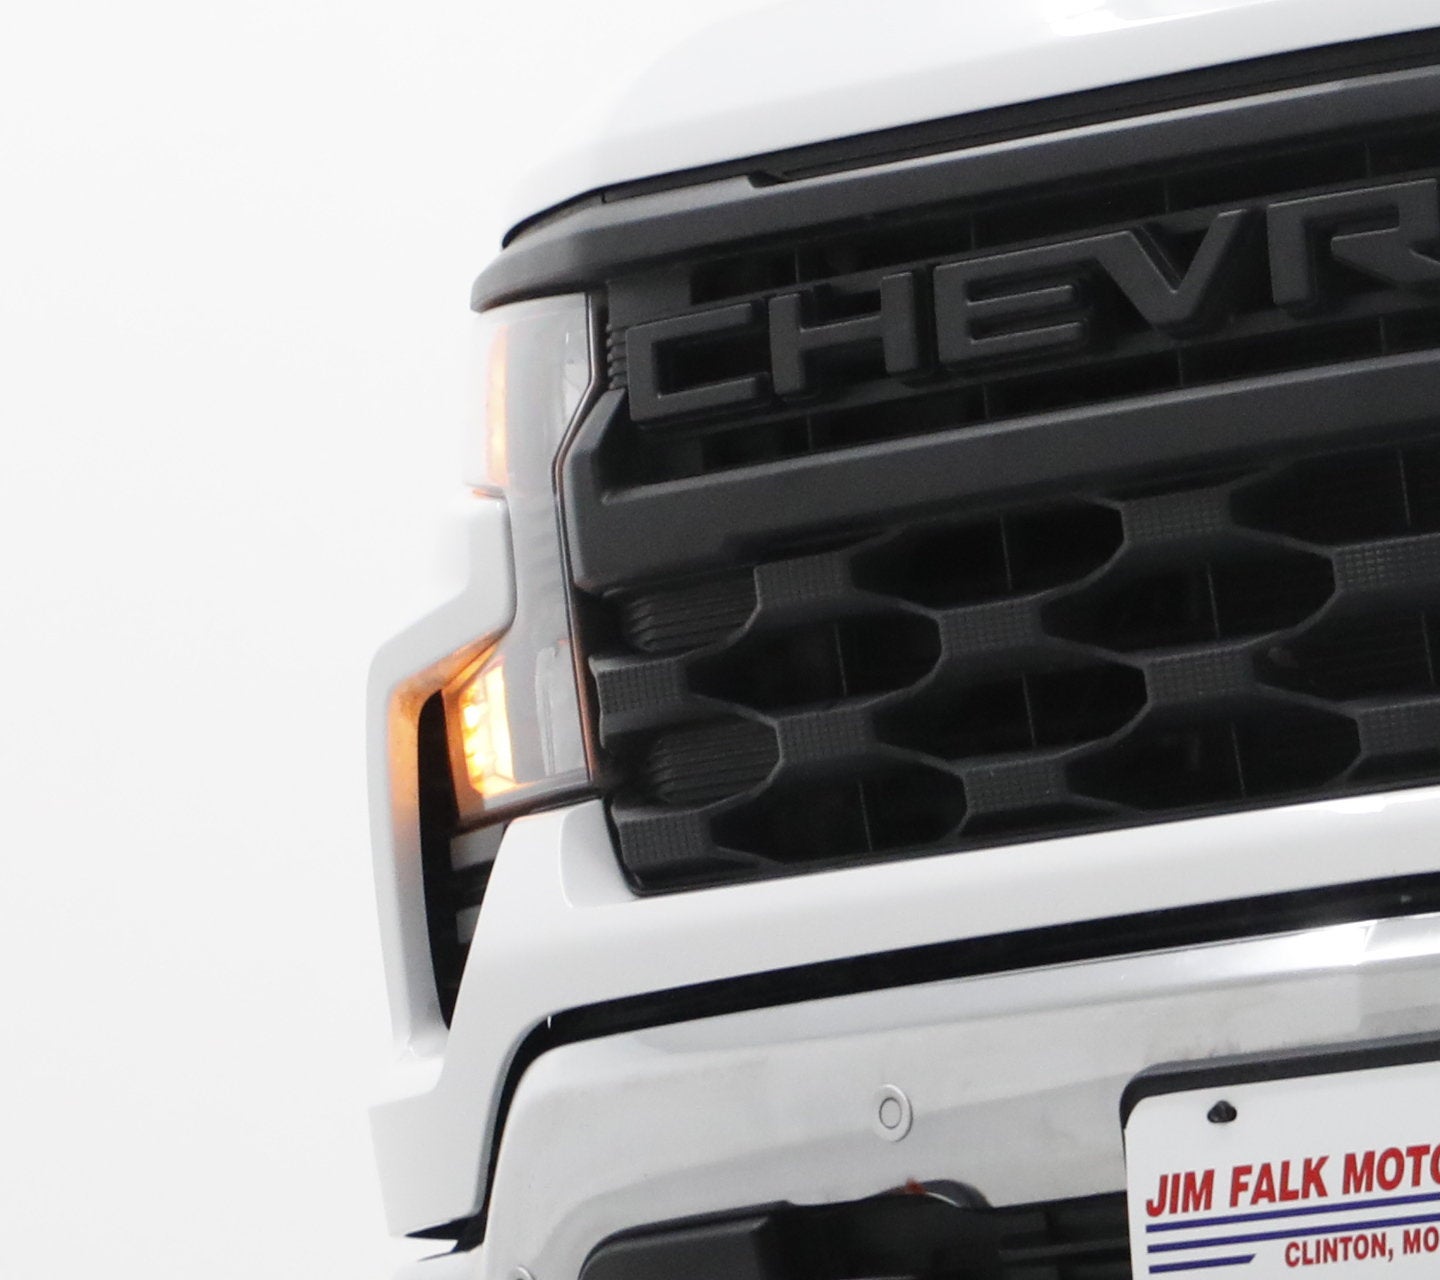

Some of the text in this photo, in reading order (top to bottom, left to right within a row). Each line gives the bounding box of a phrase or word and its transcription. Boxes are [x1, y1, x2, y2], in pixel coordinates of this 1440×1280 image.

[1146, 1169, 1215, 1217] JIM
[1229, 1155, 1329, 1207] FALK
[1284, 1226, 1440, 1268] CLINTON, MO
